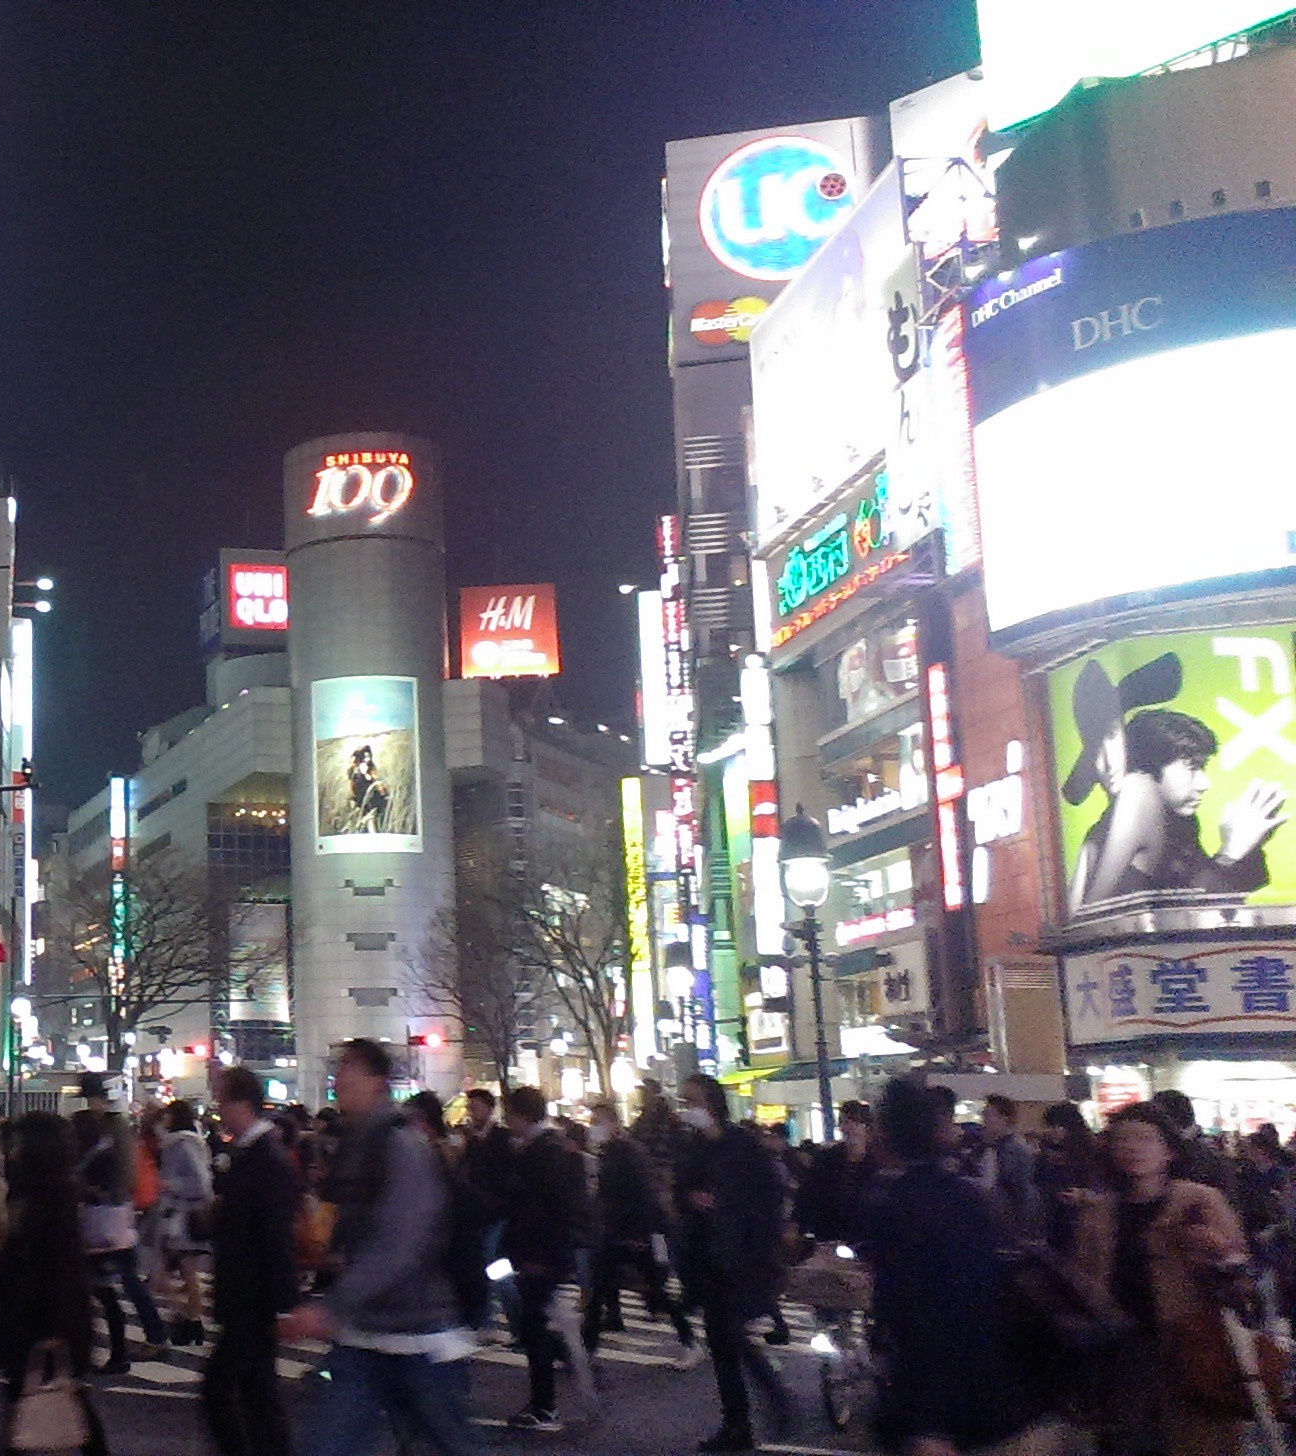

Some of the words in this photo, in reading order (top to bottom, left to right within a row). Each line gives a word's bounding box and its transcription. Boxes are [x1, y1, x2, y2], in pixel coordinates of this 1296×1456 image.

[690, 312, 760, 333] MasterC
[1071, 295, 1164, 351] DHC
[325, 452, 410, 468] SHIBUYA
[306, 464, 414, 525] 109
[478, 594, 536, 632] H&M
